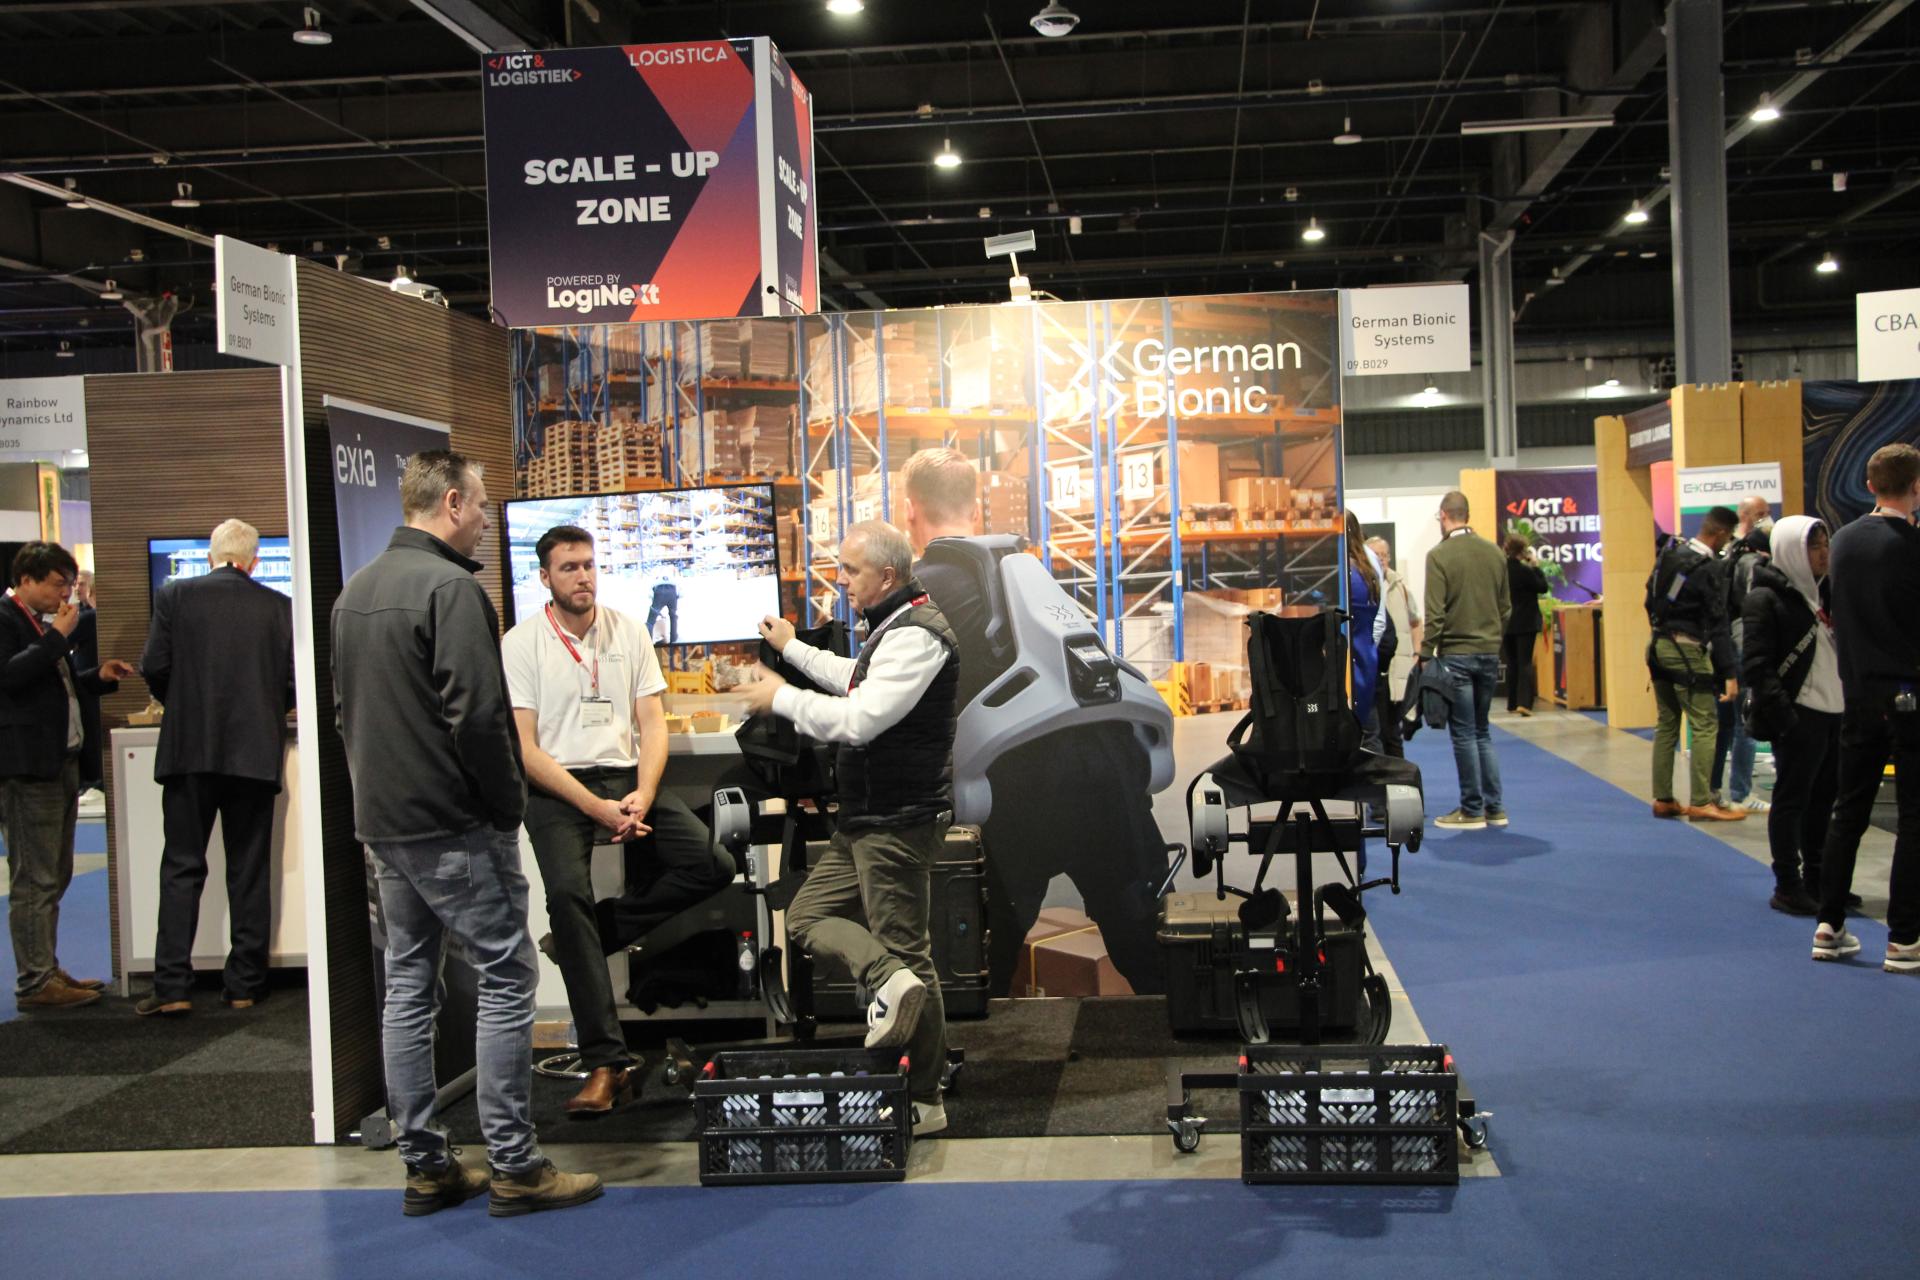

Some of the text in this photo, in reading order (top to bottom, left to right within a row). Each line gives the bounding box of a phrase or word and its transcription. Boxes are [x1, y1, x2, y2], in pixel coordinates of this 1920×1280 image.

[629, 46, 728, 67] LOGISTICA
[524, 155, 636, 185] SCALE
[671, 151, 720, 178] UP
[778, 155, 797, 195] SCALE
[576, 196, 671, 225] ZONE
[787, 204, 803, 240] ZONE
[230, 275, 287, 306] German Bionic
[547, 274, 621, 287] POWERED BY
[243, 304, 276, 327] Systems
[1351, 312, 1456, 329] German Bionic
[1374, 332, 1435, 350] Systems
[1133, 338, 1302, 377] German
[1347, 359, 1389, 370] 09.B029
[7, 397, 58, 409] Rainbow
[1135, 376, 1268, 419] Bionic
[54, 411, 73, 424] Ltd
[336, 433, 377, 487] exia
[1057, 463, 1149, 500] 14 13
[815, 512, 829, 534] 16
